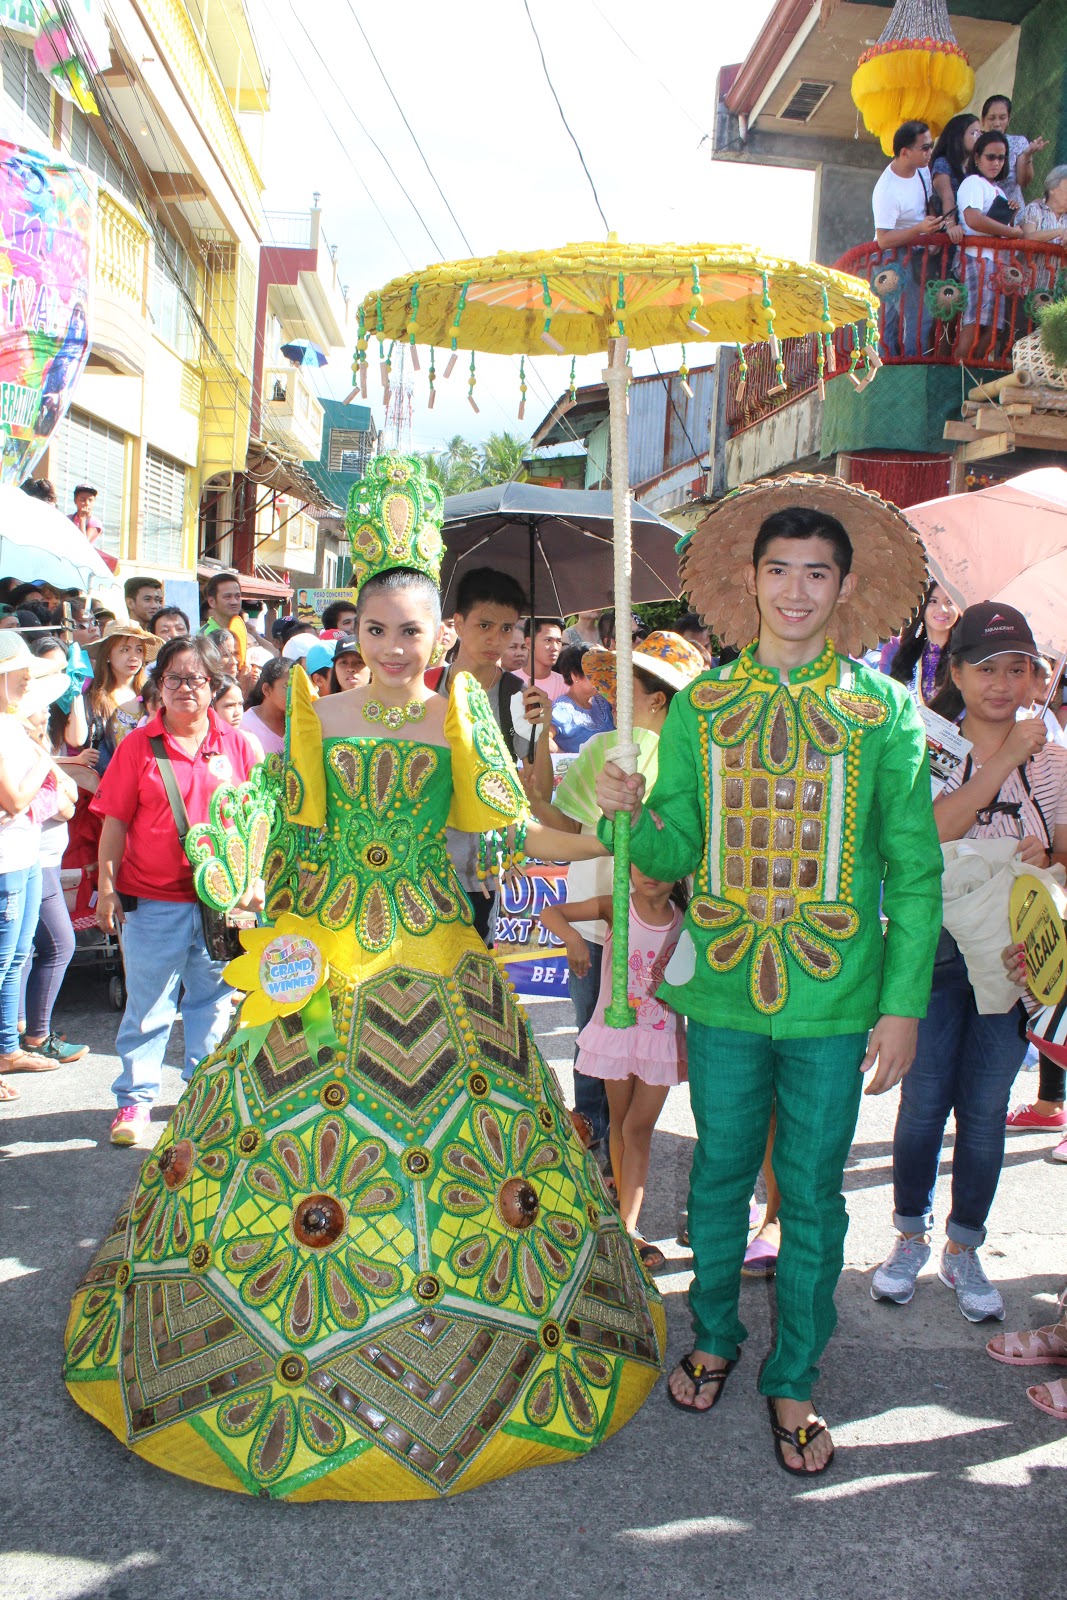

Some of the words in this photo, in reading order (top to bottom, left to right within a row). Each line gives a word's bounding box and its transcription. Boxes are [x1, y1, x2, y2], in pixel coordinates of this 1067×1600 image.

[1026, 919, 1060, 983] ALCALA
[270, 958, 312, 977] GRAND
[531, 966, 557, 984] BE
[267, 975, 316, 993] WINNER
